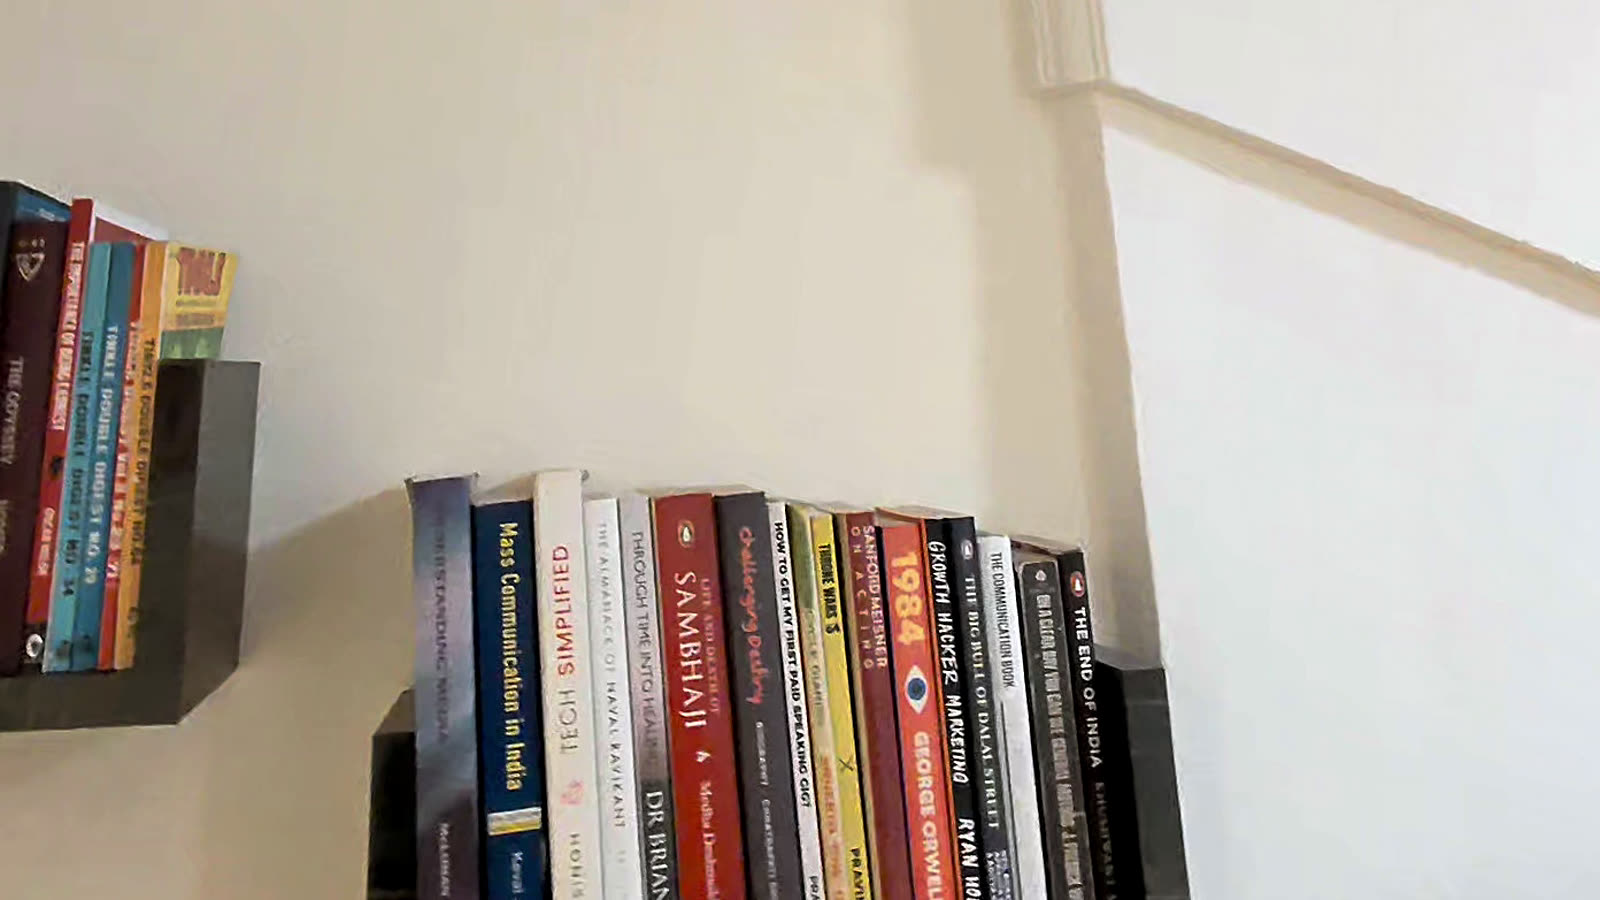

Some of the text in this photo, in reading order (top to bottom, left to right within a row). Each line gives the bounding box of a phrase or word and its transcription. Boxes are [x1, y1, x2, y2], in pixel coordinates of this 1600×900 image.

[8, 356, 24, 387] THE
[103, 325, 119, 378] TINKLE
[95, 388, 113, 453] DOUBLE
[68, 468, 84, 530] DIGEST
[88, 462, 108, 523] DIGEST
[595, 522, 608, 552] THE
[773, 522, 787, 554] HOW
[817, 543, 835, 585] THRONE
[632, 531, 649, 609] THROUGH
[777, 558, 788, 575] TO
[779, 577, 791, 605] GET
[782, 607, 794, 625] MY
[821, 587, 838, 619] WARS
[851, 527, 875, 669] ON ACTING
[863, 525, 888, 668] SANFORD MEISNER
[891, 551, 925, 646] 1984
[989, 551, 1015, 689] THE COMMUNICATION BOOK
[499, 522, 527, 791] Mass Communication in India
[552, 545, 579, 754] SIMPLIFIED TECH
[636, 612, 652, 650] TIME
[673, 571, 707, 729] SAMBHAJI
[784, 630, 799, 667] FIRST
[1039, 619, 1055, 649] CLEAR
[637, 652, 656, 692] INTO
[788, 670, 803, 701] PAID
[927, 541, 970, 784] GROWTH HACKER MARKETING
[1074, 607, 1103, 768] THE END OF INDIA
[606, 682, 620, 736] NAVAL
[963, 575, 1000, 829] THE BIG BULL OF DALAL STREET
[792, 704, 810, 776] SPEAKING
[608, 742, 626, 828] RAVIKANT
[913, 732, 937, 817] GEORGE
[645, 790, 664, 822] DR
[956, 818, 979, 868] RYAN
